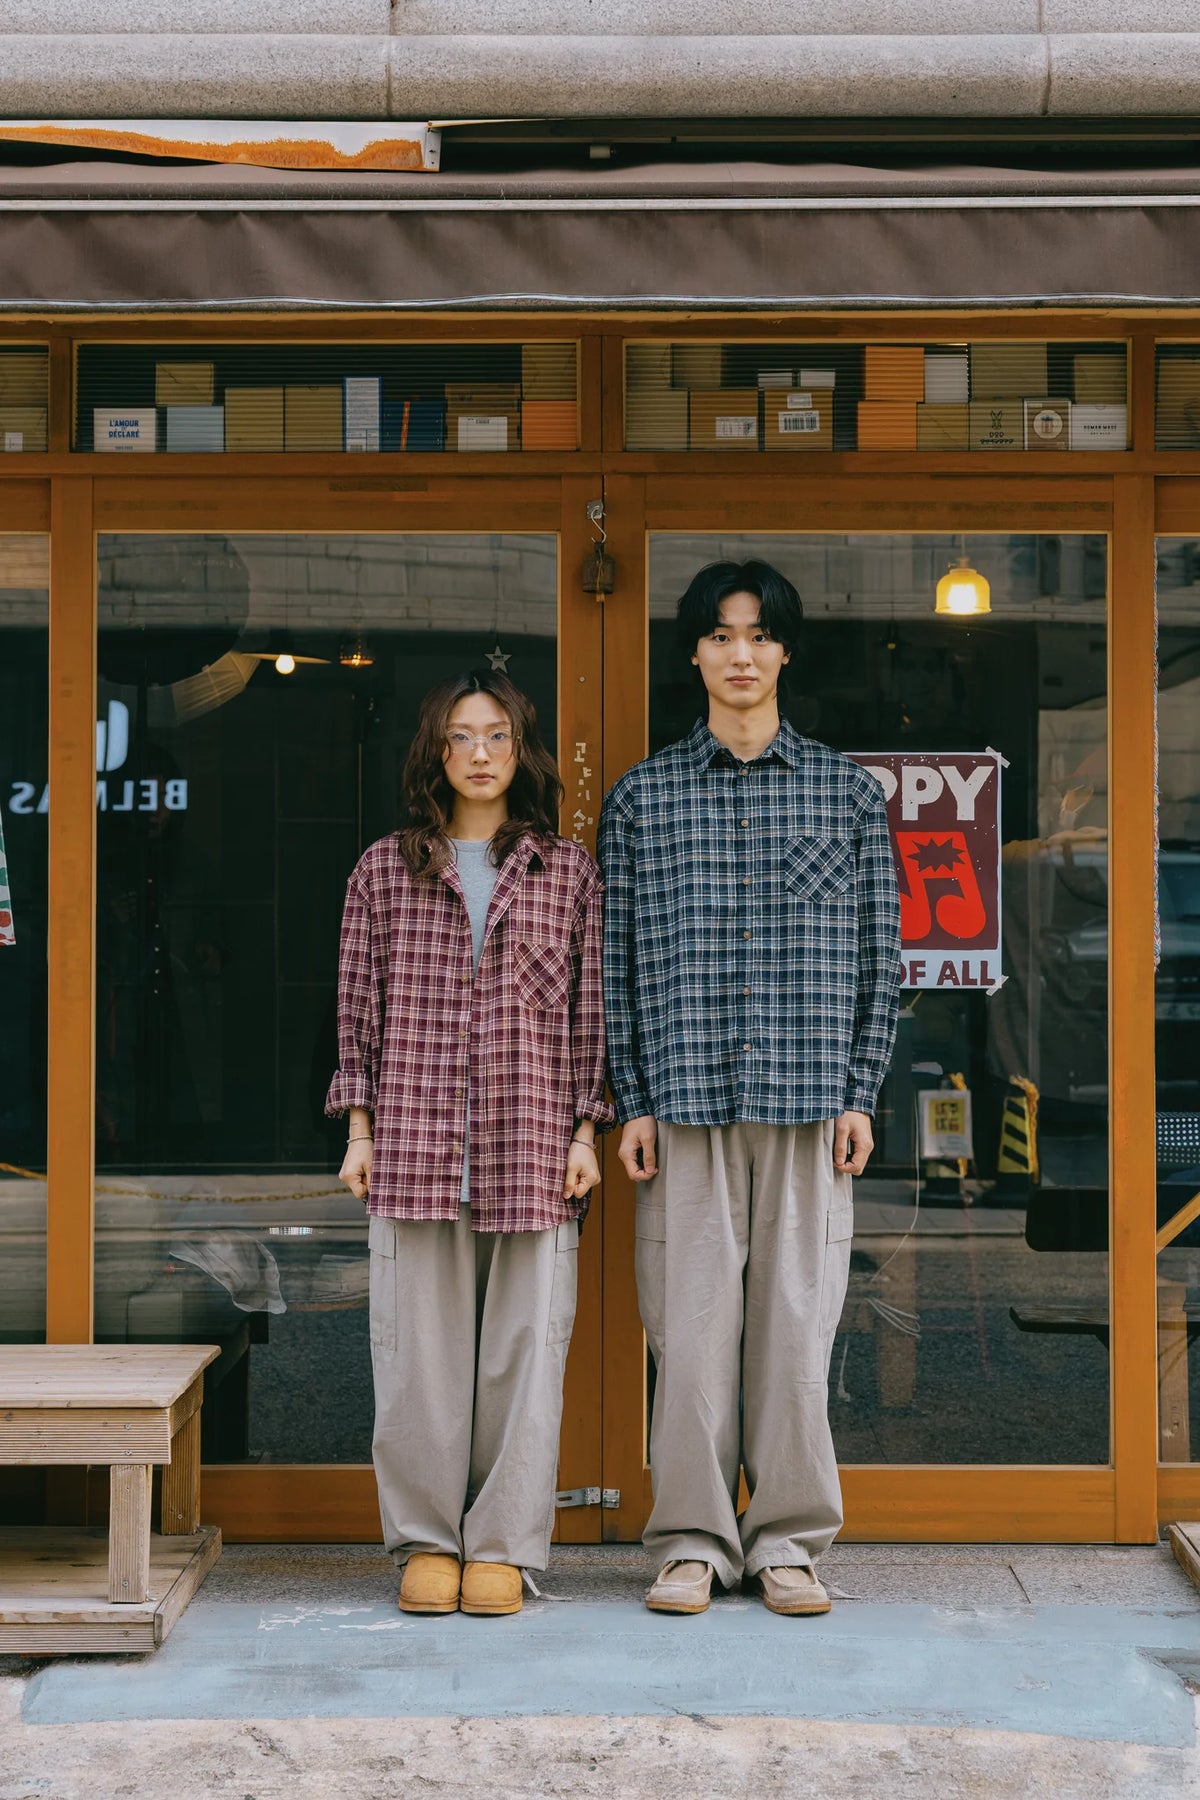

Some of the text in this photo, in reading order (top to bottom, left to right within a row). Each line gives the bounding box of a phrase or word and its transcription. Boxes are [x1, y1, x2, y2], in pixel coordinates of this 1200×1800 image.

[108, 429, 139, 438] DÉCLARÉ
[899, 960, 996, 986] F ALL
